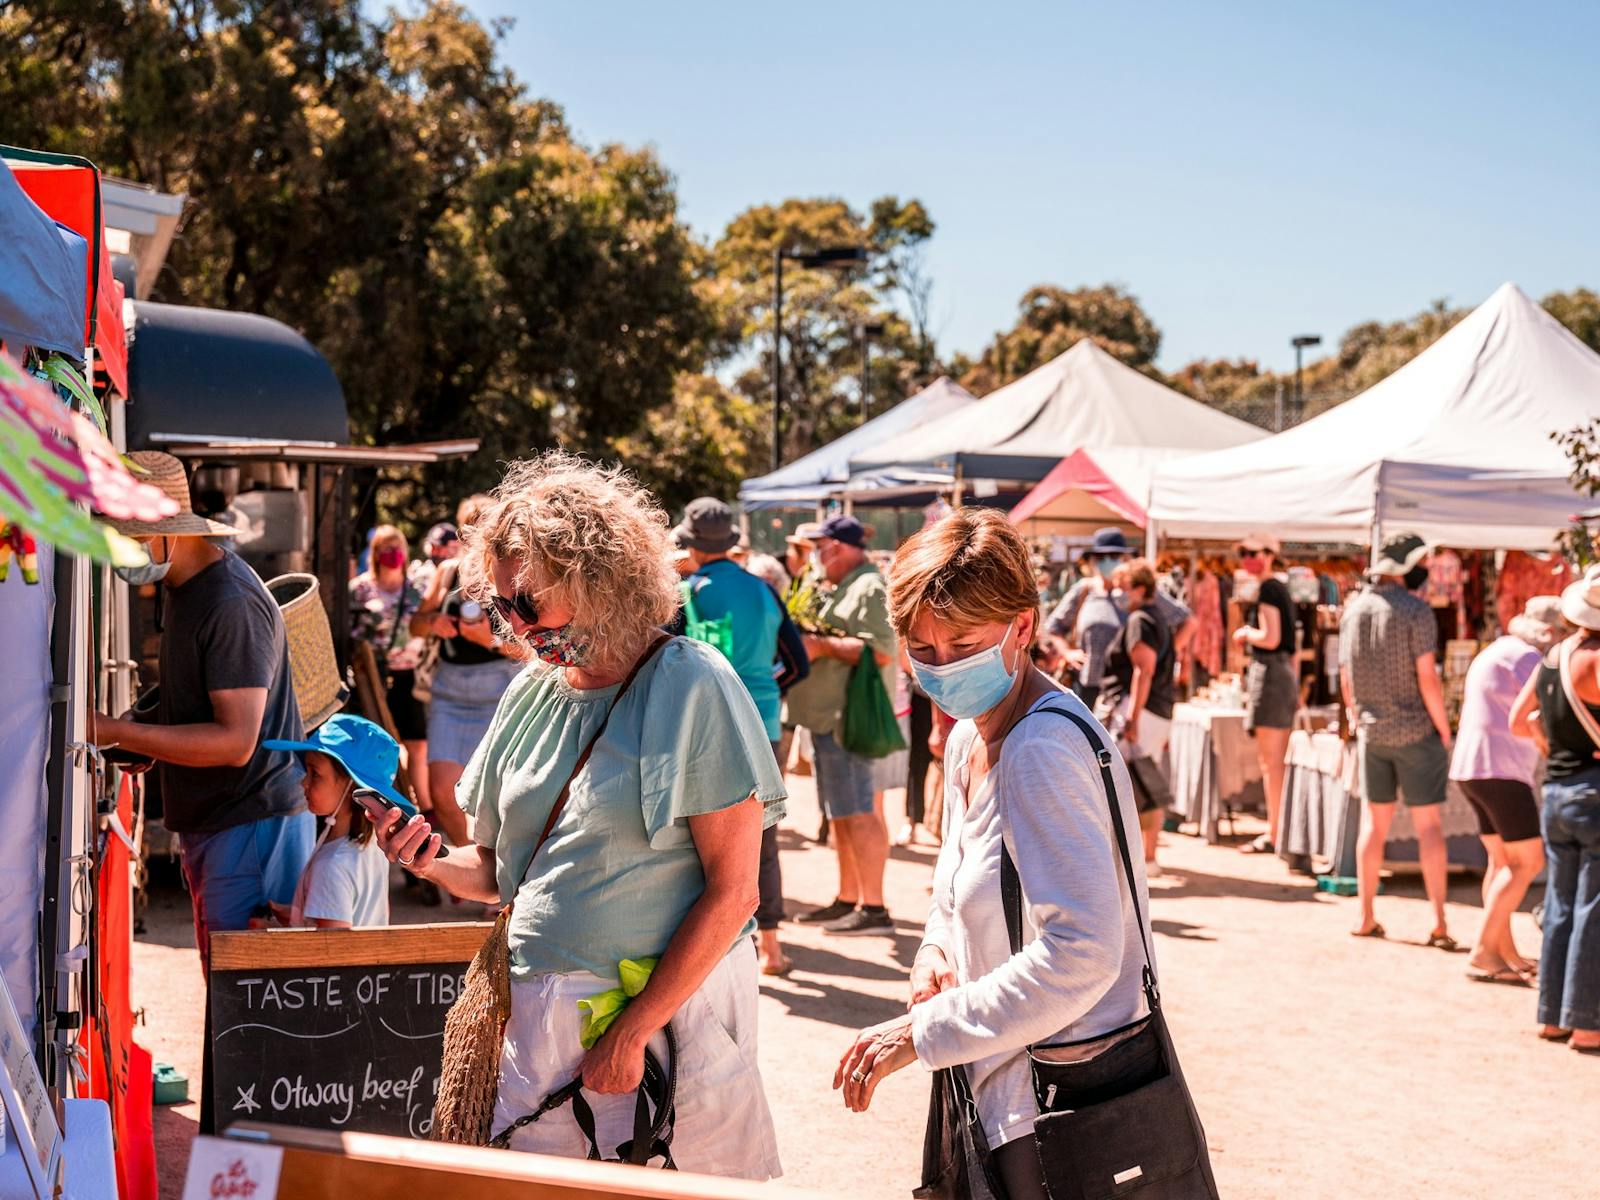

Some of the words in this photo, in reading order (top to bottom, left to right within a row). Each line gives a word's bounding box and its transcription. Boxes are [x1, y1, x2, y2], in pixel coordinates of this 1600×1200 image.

[236, 975, 343, 1010] TASTE
[356, 973, 391, 1005] OF
[270, 1074, 354, 1125] Otway
[362, 1061, 424, 1114] beef
